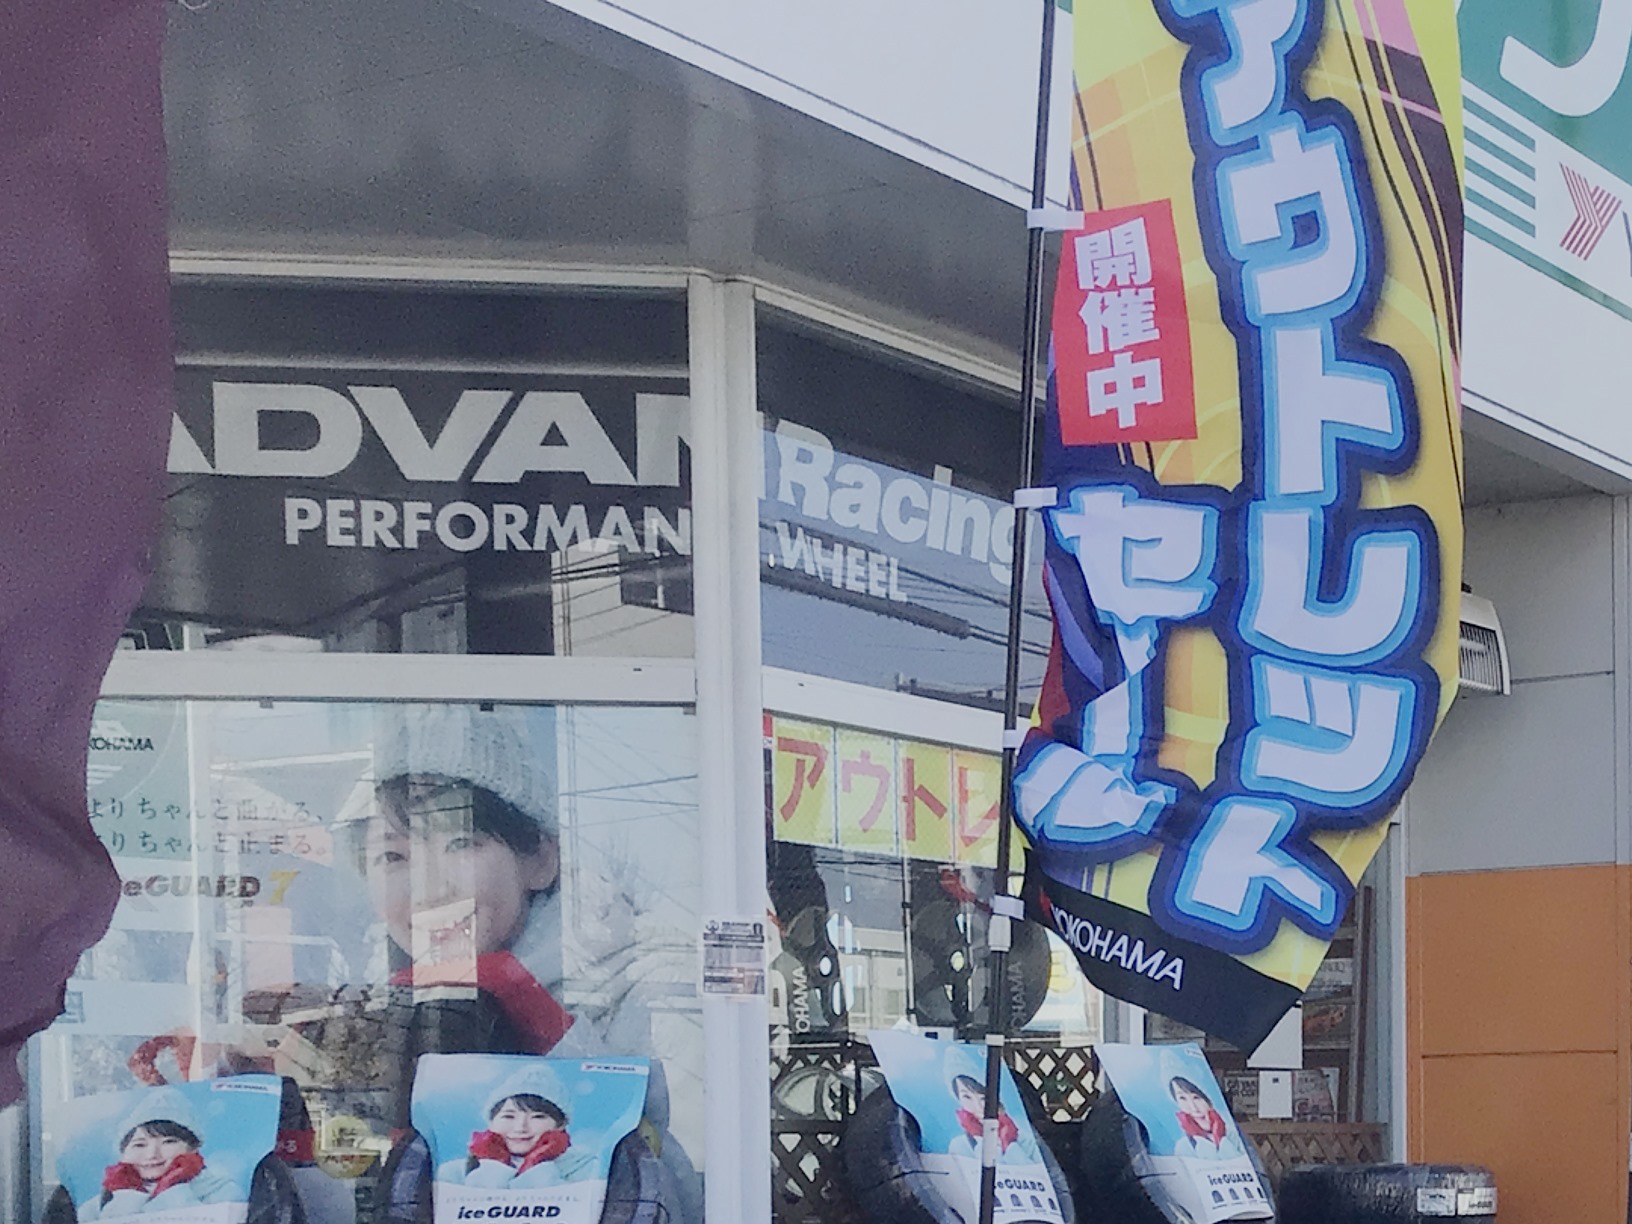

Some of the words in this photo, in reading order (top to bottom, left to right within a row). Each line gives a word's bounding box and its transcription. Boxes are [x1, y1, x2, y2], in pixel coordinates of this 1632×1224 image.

[1074, 217, 1164, 430] 開催中
[284, 498, 692, 554] PERFORMAN
[774, 418, 1034, 585] Racing
[776, 520, 908, 602] WHEEL
